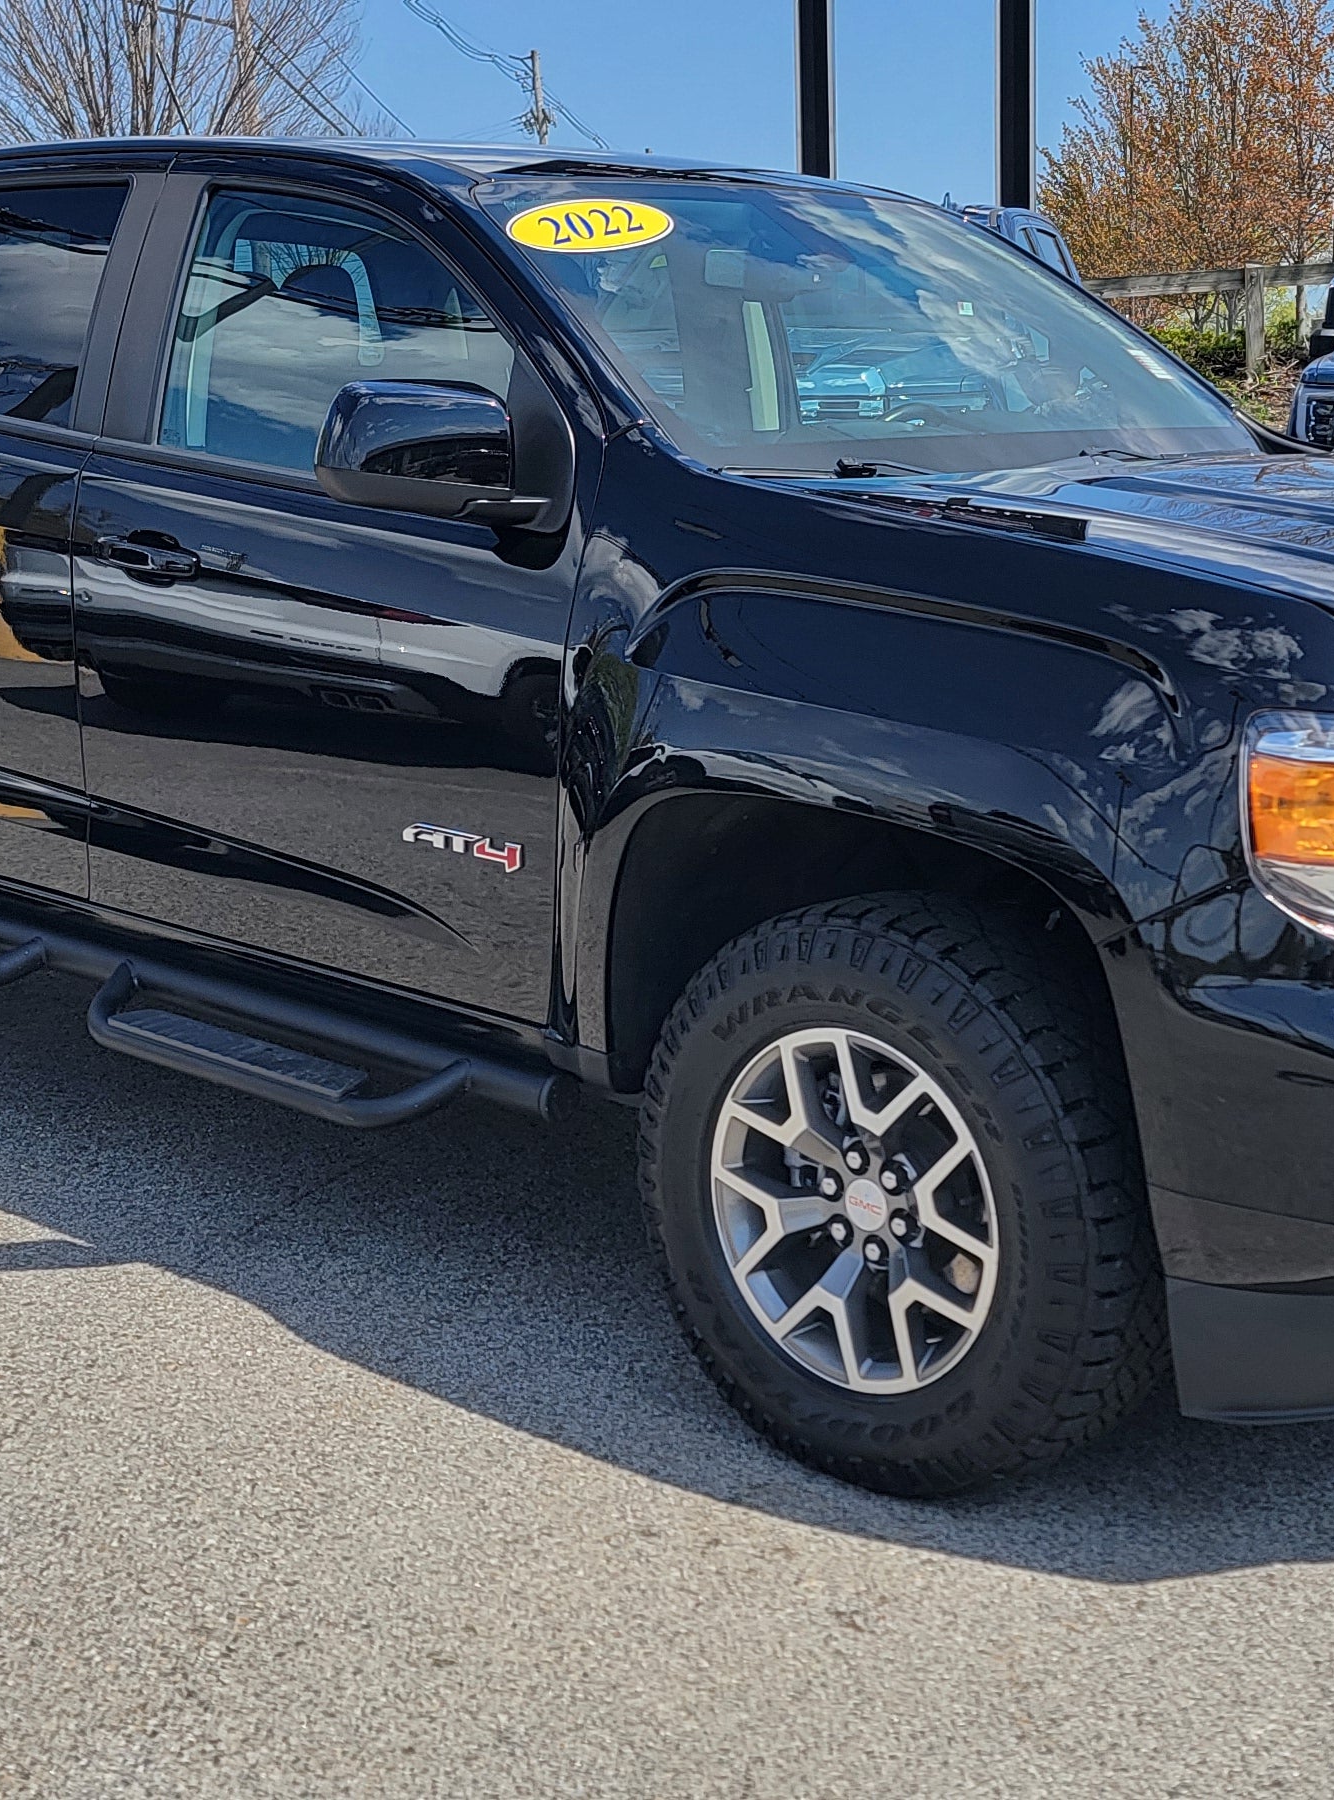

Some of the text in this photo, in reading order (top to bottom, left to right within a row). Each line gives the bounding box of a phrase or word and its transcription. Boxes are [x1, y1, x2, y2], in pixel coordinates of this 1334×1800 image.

[538, 205, 644, 245] 2022
[402, 822, 522, 873] AT4
[711, 980, 1005, 1148] WRANGLER
[848, 1195, 883, 1216] GMC
